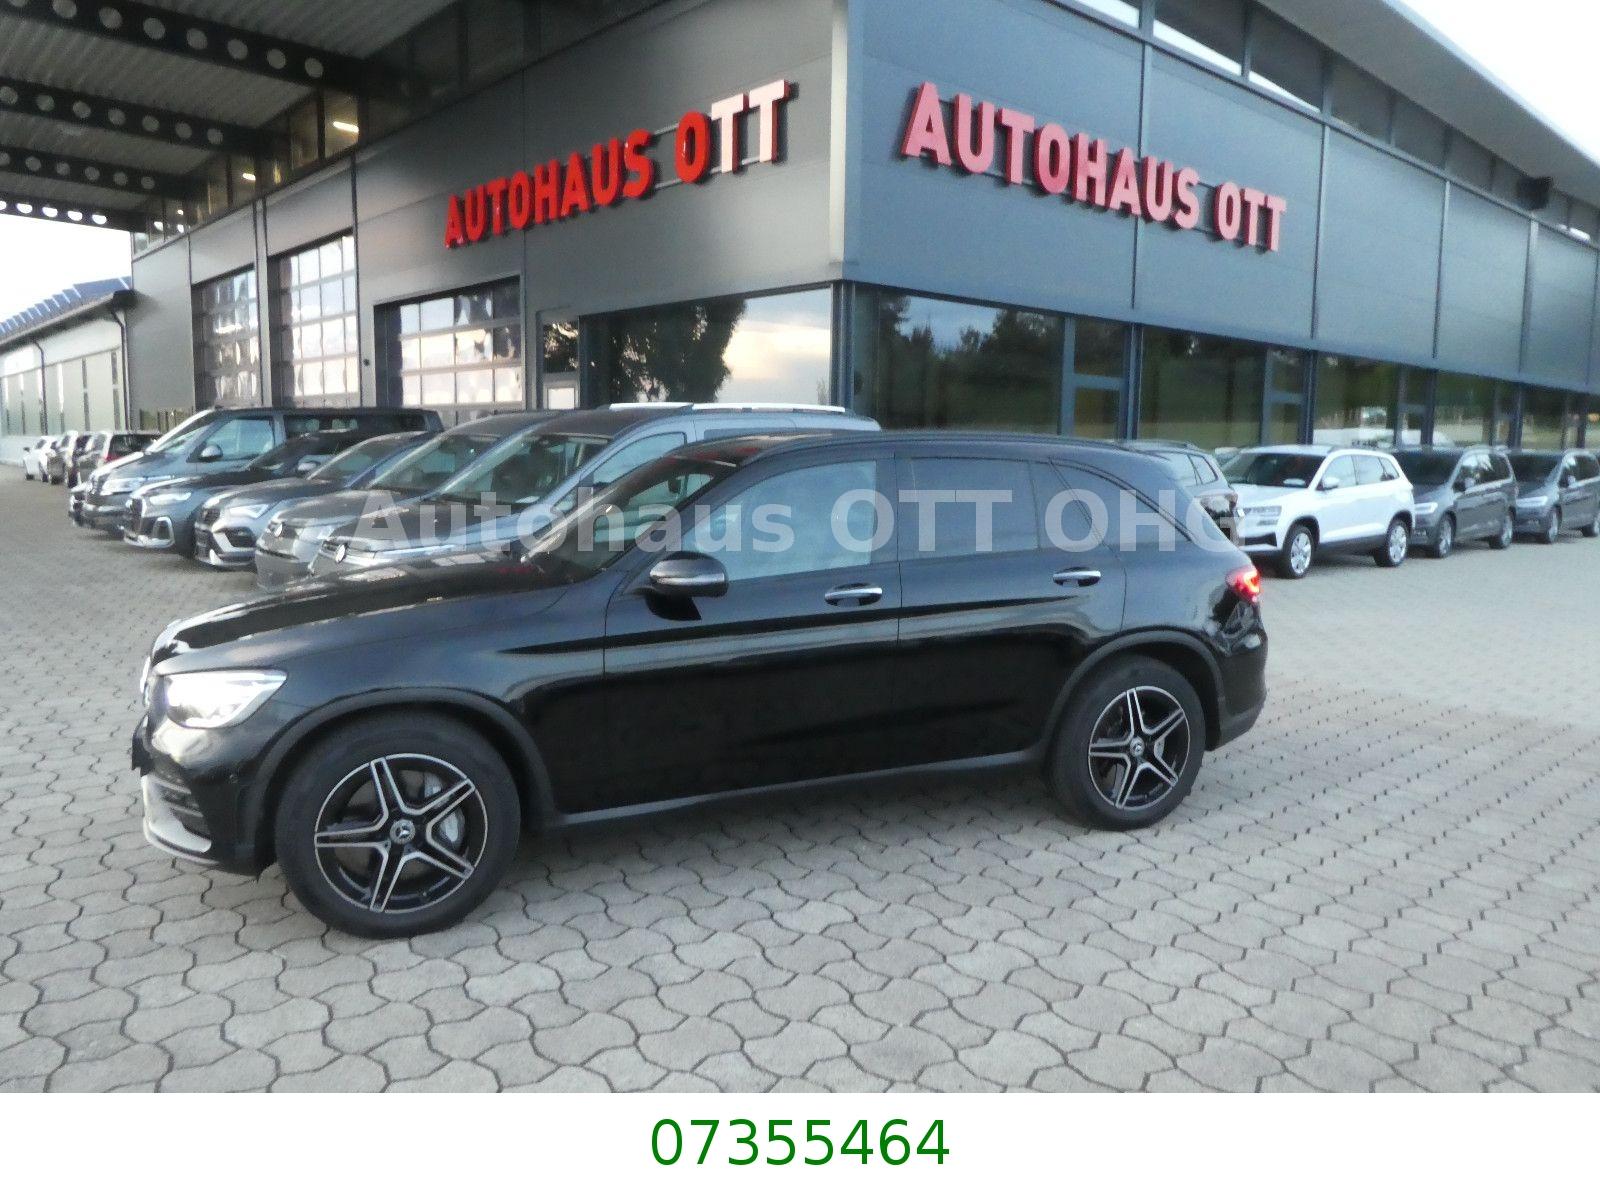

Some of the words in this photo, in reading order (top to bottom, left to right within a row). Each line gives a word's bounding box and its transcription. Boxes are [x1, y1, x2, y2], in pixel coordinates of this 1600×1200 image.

[444, 129, 654, 249] AUTOHAUS
[674, 79, 791, 184] OTT
[901, 81, 1200, 230] AUTOHAUS
[1214, 181, 1287, 252] OTT
